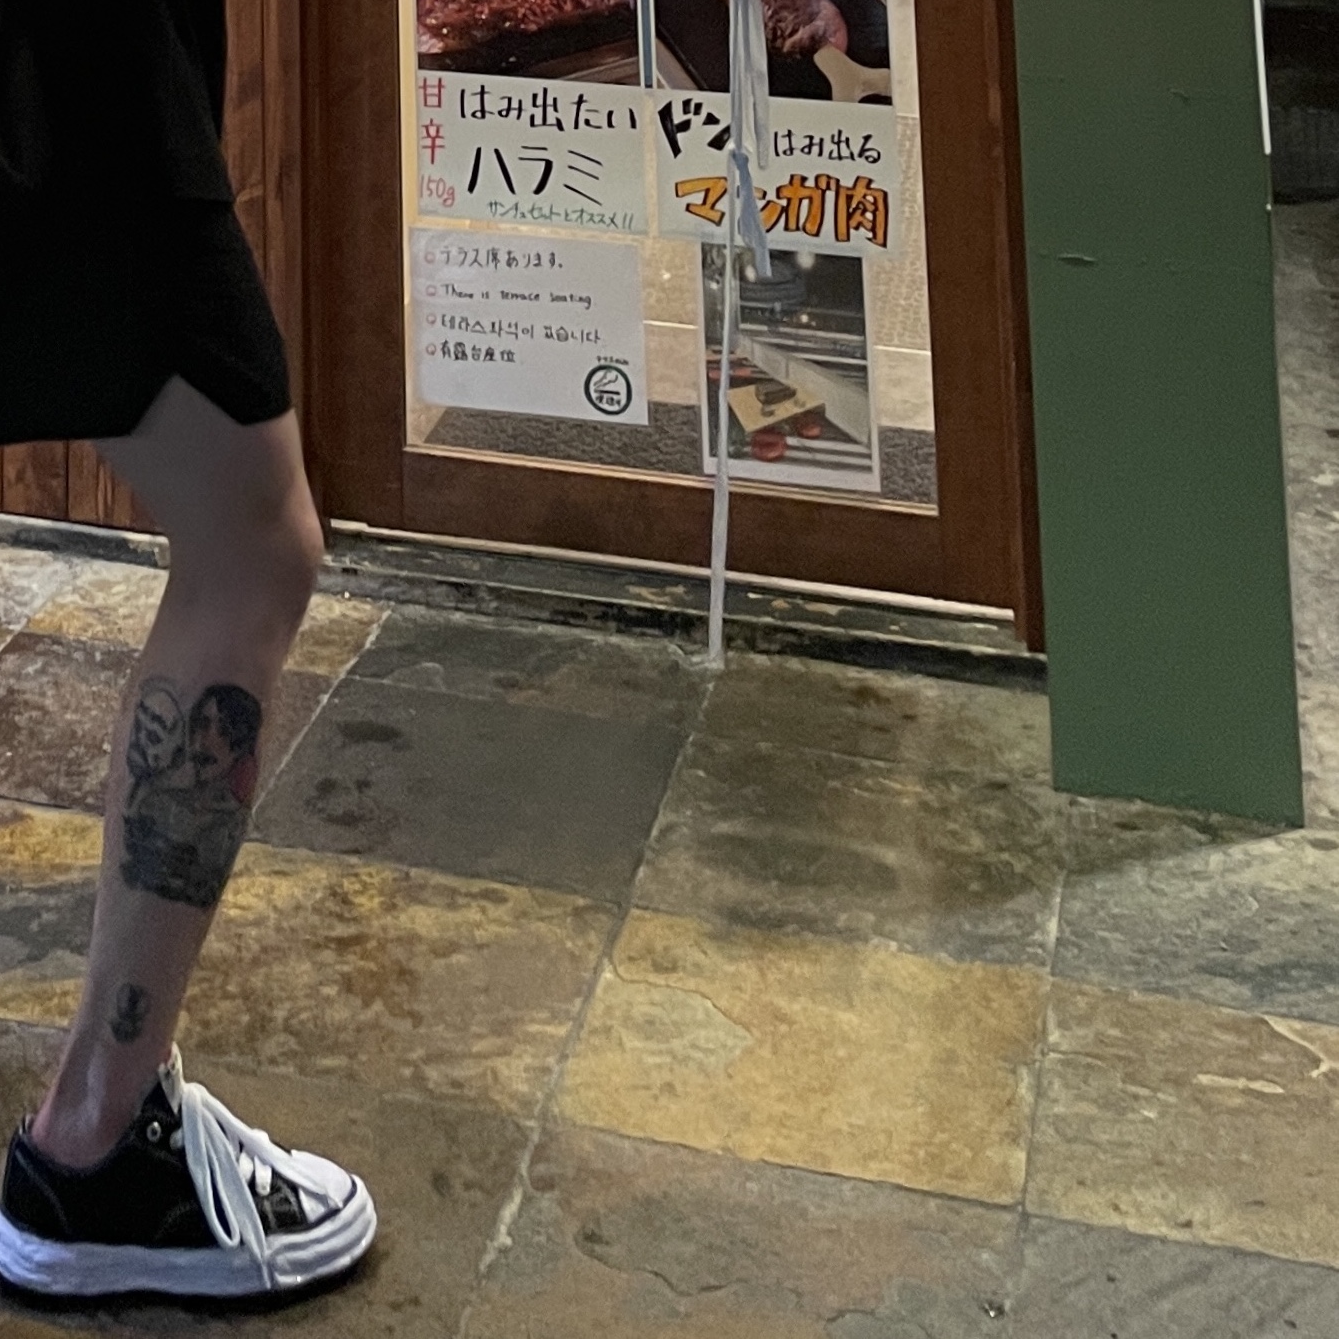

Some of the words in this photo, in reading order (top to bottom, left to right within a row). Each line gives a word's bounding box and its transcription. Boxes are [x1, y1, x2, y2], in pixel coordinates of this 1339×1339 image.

[460, 84, 638, 132] はみ出たい
[774, 127, 882, 165] はみ出る
[419, 173, 456, 208] 150g
[466, 145, 604, 206] ハラミ
[440, 246, 564, 271] テラス席あります。
[441, 283, 474, 300] There
[481, 290, 491, 300] is
